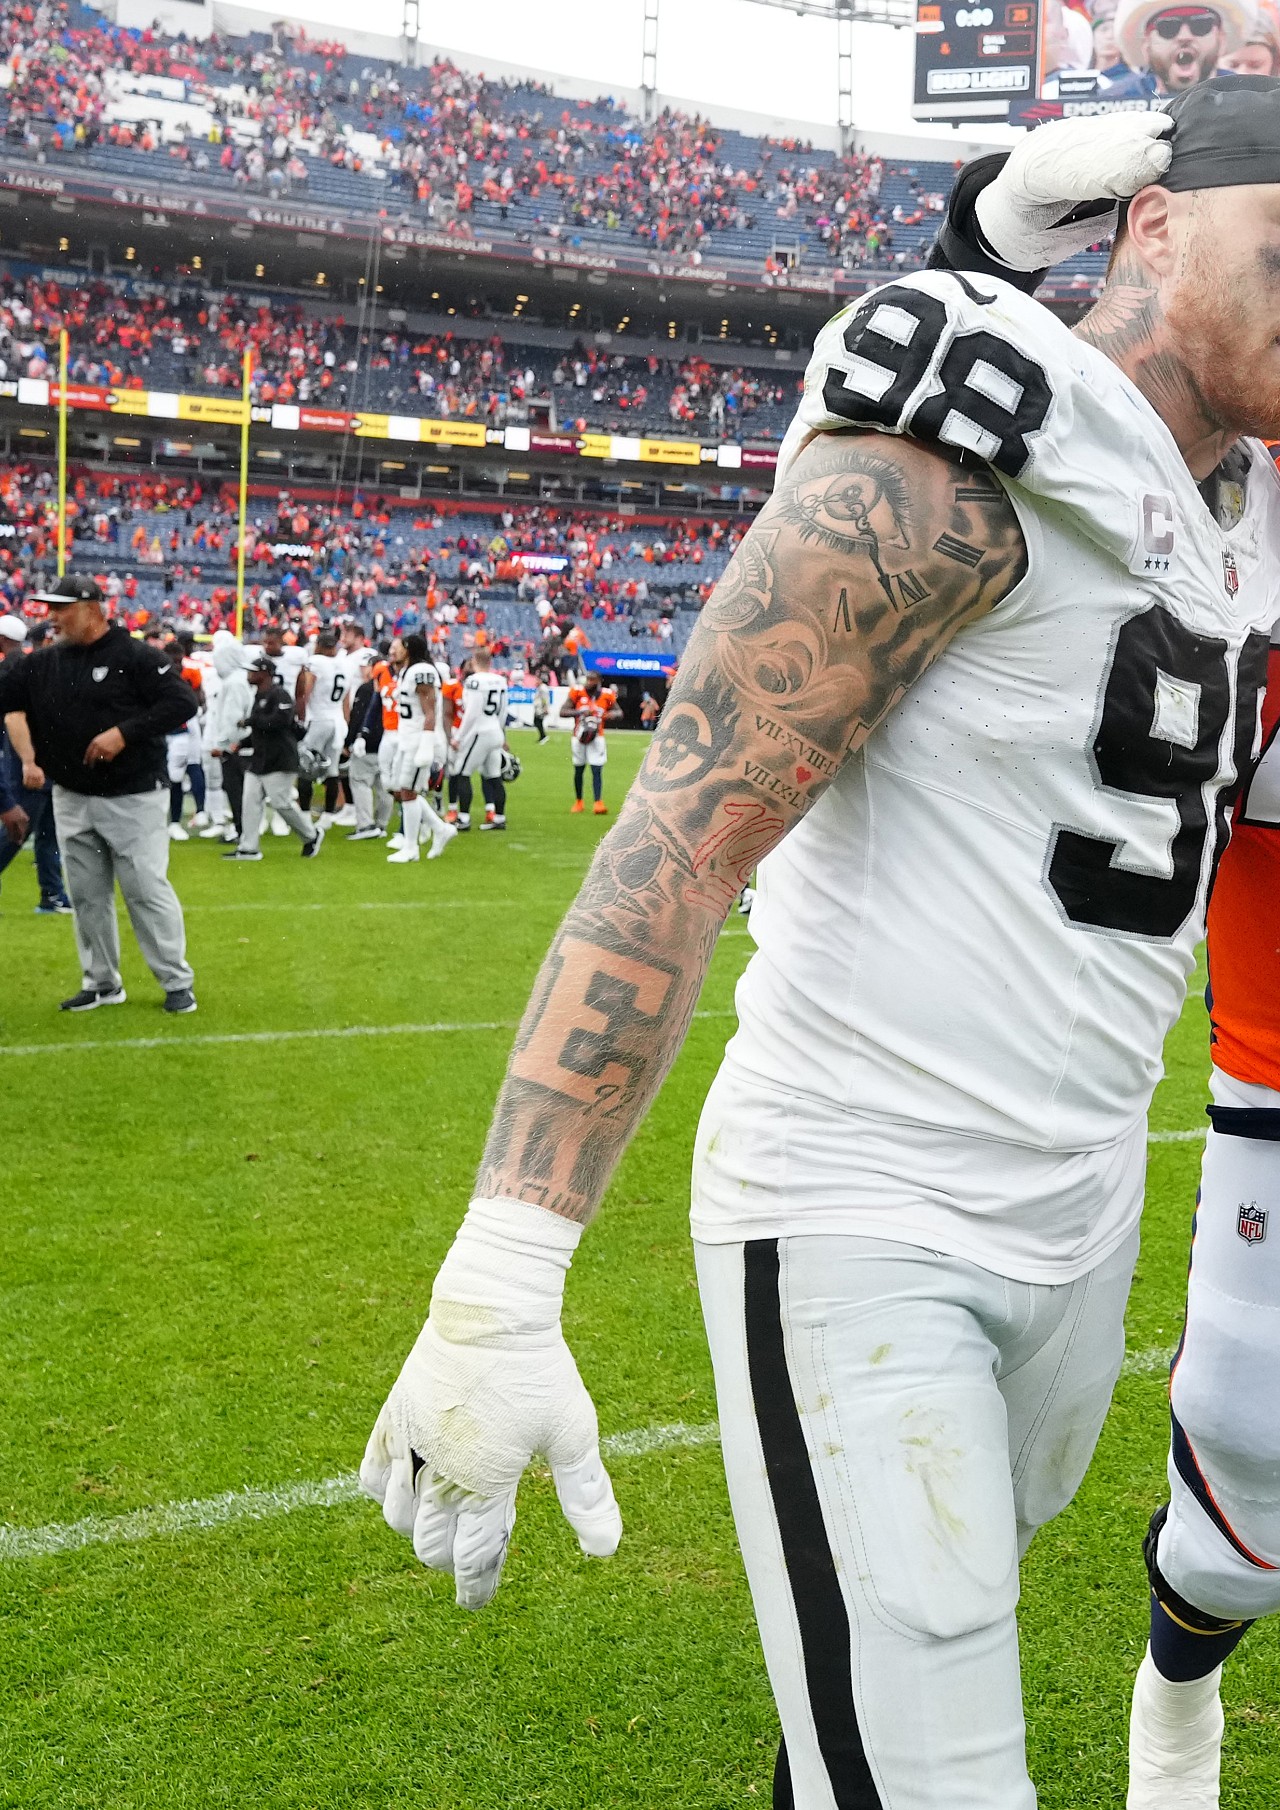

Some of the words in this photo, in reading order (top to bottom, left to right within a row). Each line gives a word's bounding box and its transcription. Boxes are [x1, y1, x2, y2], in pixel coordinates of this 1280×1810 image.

[932, 73, 970, 90] BUD
[970, 71, 1026, 88] LIGHT
[822, 285, 1055, 479] 98
[1143, 494, 1174, 555] C
[616, 658, 661, 671] centura
[331, 674, 345, 702] 6
[1240, 1219, 1262, 1239] NFL
